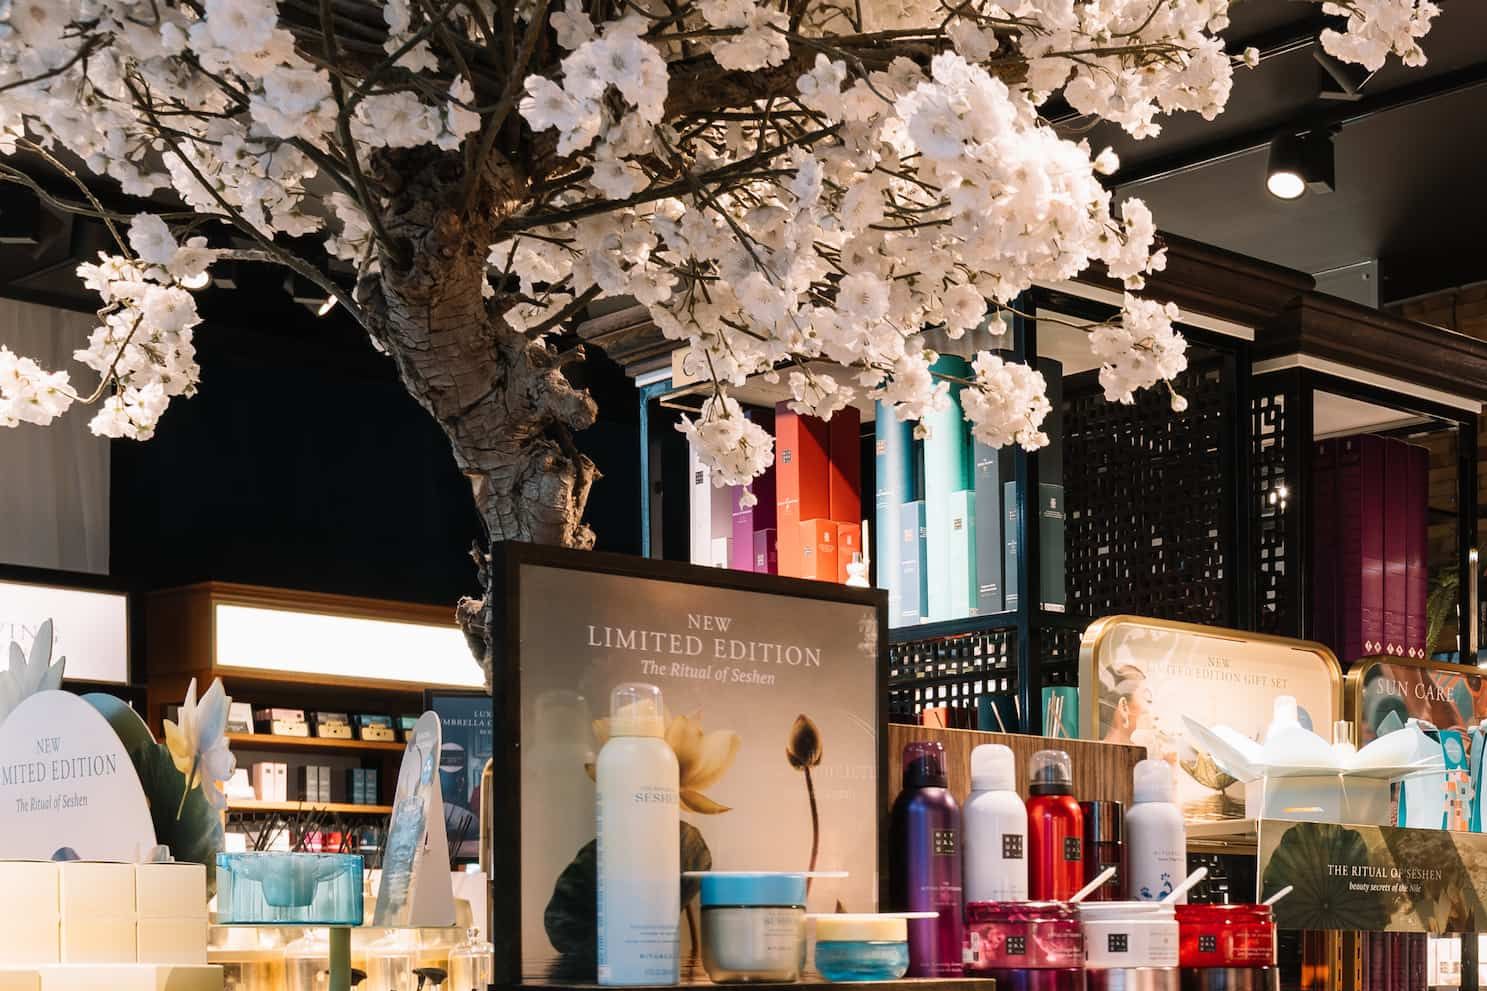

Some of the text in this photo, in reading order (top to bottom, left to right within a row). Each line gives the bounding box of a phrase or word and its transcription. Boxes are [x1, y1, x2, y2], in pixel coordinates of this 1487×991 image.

[687, 613, 732, 632] NEW
[587, 625, 822, 667] LIMITED EDITION
[1207, 656, 1231, 668] NEW
[641, 659, 776, 685] The Ritual of Seshen
[1196, 667, 1241, 683] EDITION
[1376, 679, 1455, 702] SUN CARE
[440, 719, 484, 727] MBRELLA
[36, 737, 61, 754] NEW
[51, 754, 118, 782] EDITION
[16, 793, 88, 813] The Ritual of Seshen
[1327, 864, 1442, 880] THE RITUAL OF SESHEN
[1349, 881, 1370, 893] beauty
[1370, 883, 1391, 892] secrets
[1391, 883, 1399, 893] of
[1399, 883, 1408, 892] the
